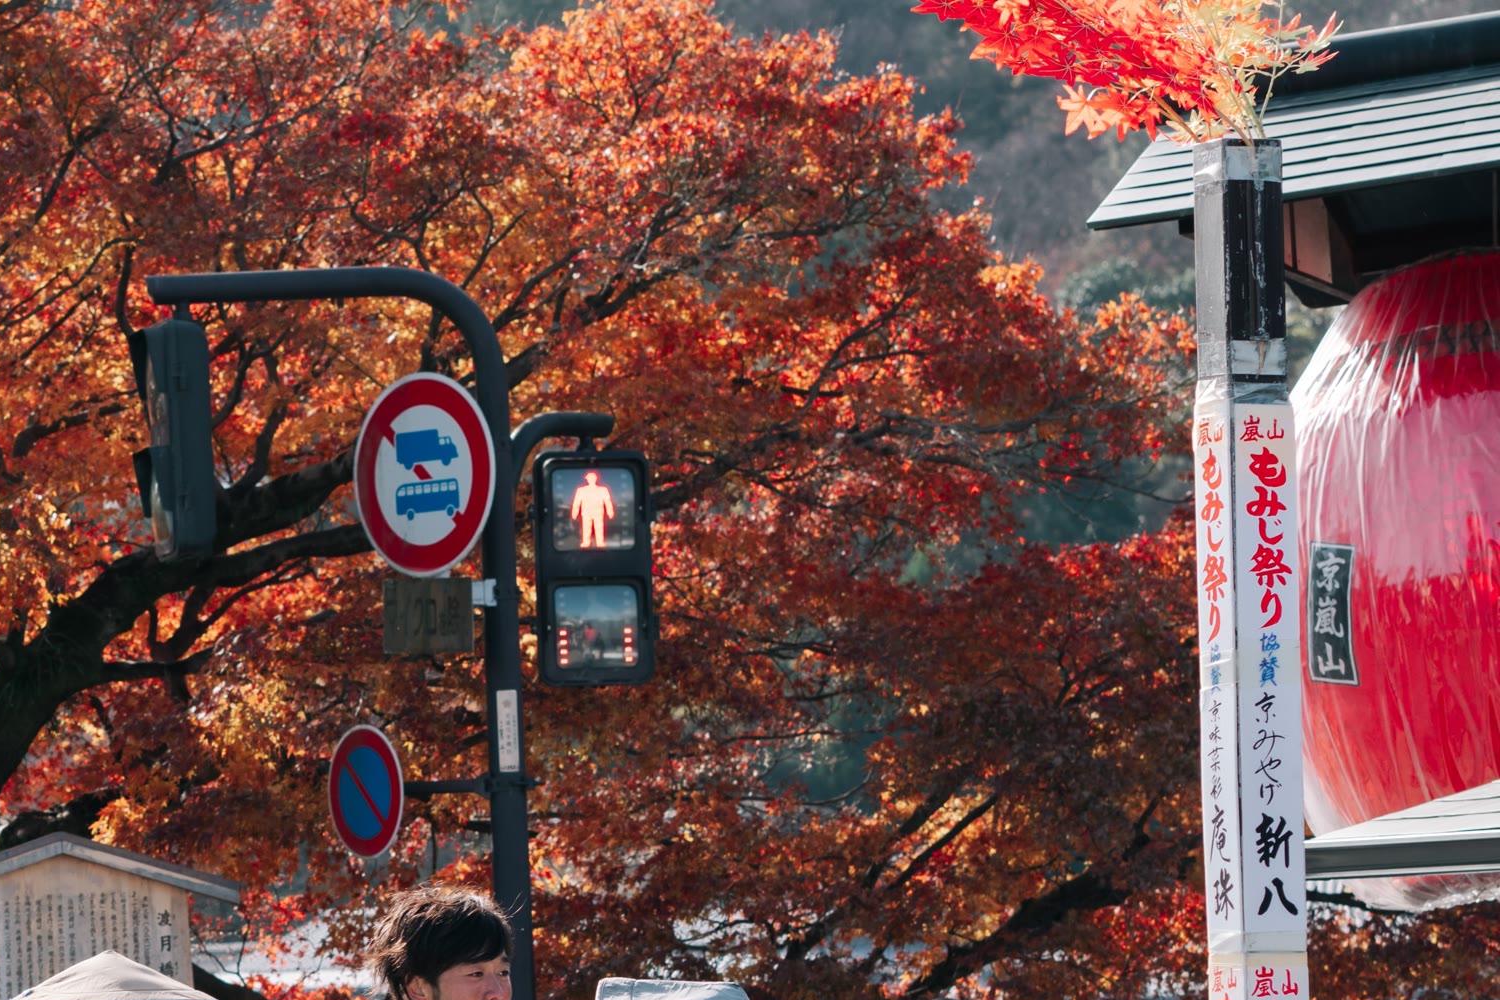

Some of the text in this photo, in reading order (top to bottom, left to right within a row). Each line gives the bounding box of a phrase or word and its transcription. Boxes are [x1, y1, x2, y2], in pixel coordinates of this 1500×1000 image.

[1240, 415, 1285, 442] 嵐山
[1201, 447, 1228, 644] もみじ祭り
[1246, 446, 1293, 629] もみじ祭り
[1314, 552, 1347, 676] 京嵐山
[1258, 632, 1281, 688] 協賛
[1252, 691, 1299, 916] 京みやげ 新八
[1211, 966, 1238, 993] 嵐山
[1251, 966, 1300, 998] 嵐山
